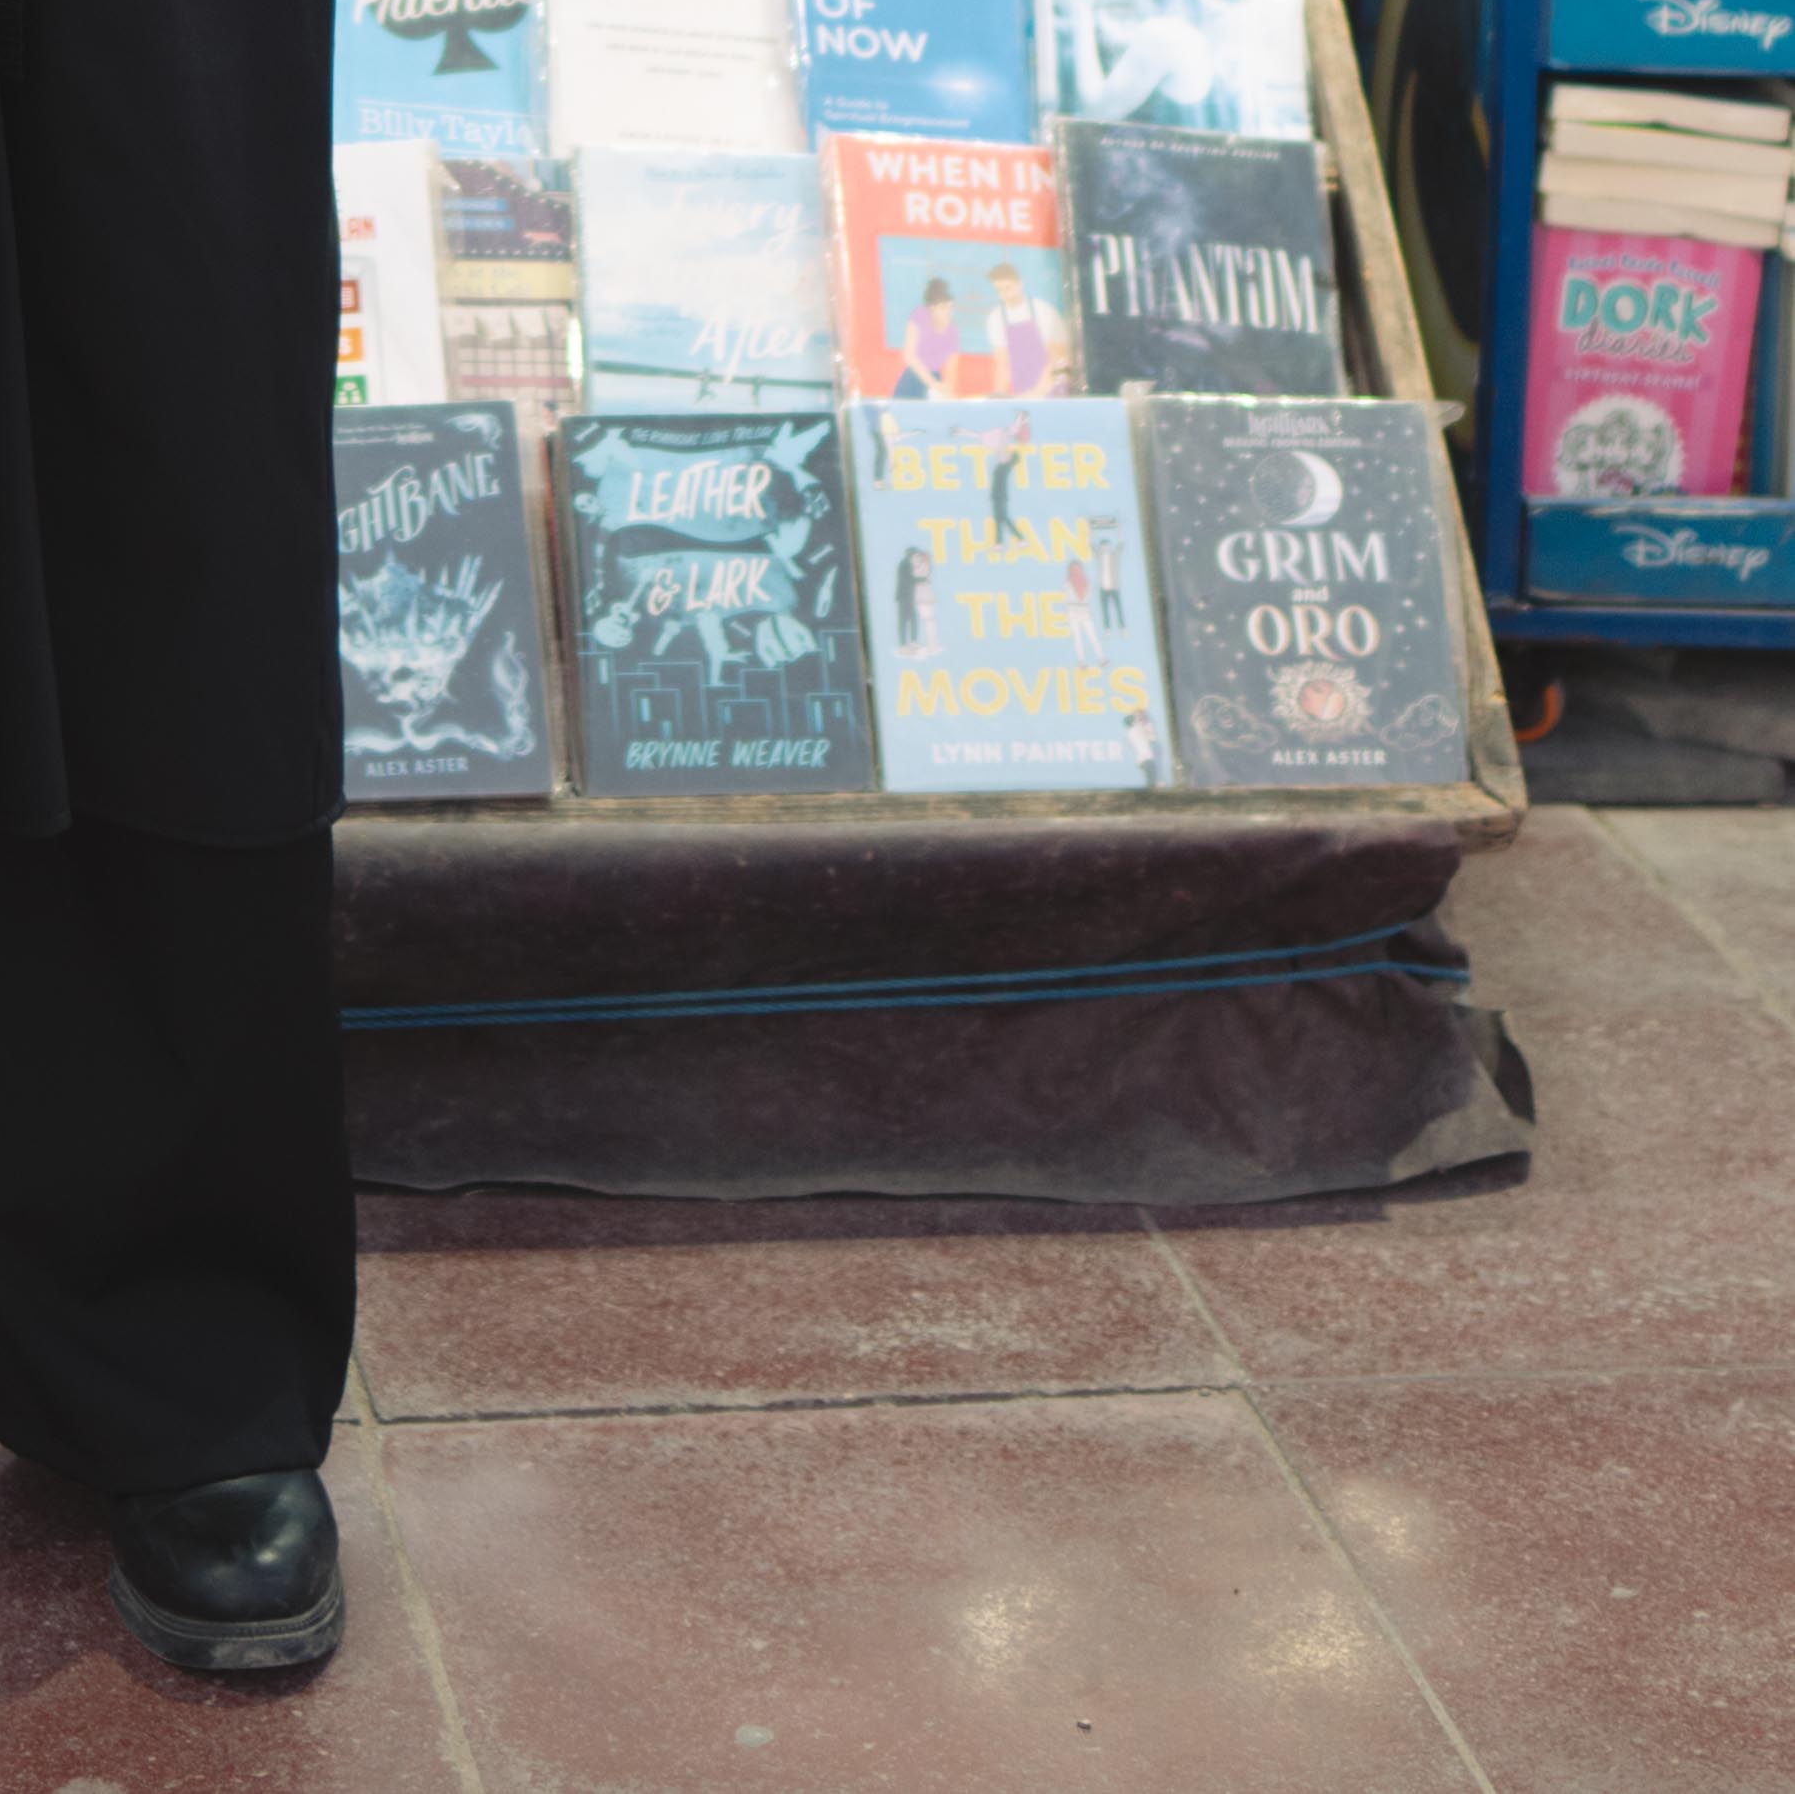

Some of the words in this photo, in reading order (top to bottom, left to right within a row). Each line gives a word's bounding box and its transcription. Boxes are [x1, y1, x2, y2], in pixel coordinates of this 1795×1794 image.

[816, 25, 929, 64] NOW
[359, 106, 435, 144] Billy
[439, 113, 532, 153] Taylo
[865, 149, 1000, 190] WHEN
[1013, 163, 1055, 193] IN
[905, 191, 1033, 233] ROME
[1090, 231, 1320, 334] PHANTOM
[1562, 277, 1719, 343] DORK
[690, 301, 814, 384] After
[1578, 318, 1696, 364] diaries
[891, 443, 1111, 492] BETTER
[338, 452, 502, 555] GHTBANE
[627, 461, 771, 524] LEATHER
[917, 517, 1094, 564] THAN
[1216, 529, 1393, 584] GRIM
[1610, 522, 1772, 581] Disney
[647, 569, 680, 616] &
[686, 558, 772, 610] LARK
[1292, 585, 1330, 605] and
[956, 592, 1073, 639] THE
[1245, 602, 1382, 662] ORO
[896, 666, 1149, 717] MOVIES
[365, 757, 408, 777] ALEX
[413, 755, 469, 776] ASTER
[624, 738, 722, 772] BRYNNE
[730, 738, 832, 771] WEAVER
[931, 740, 1003, 765] LYNN
[1010, 740, 1125, 764] PAINTER
[1271, 749, 1321, 767] ALEX
[1325, 749, 1388, 767] ASTER
